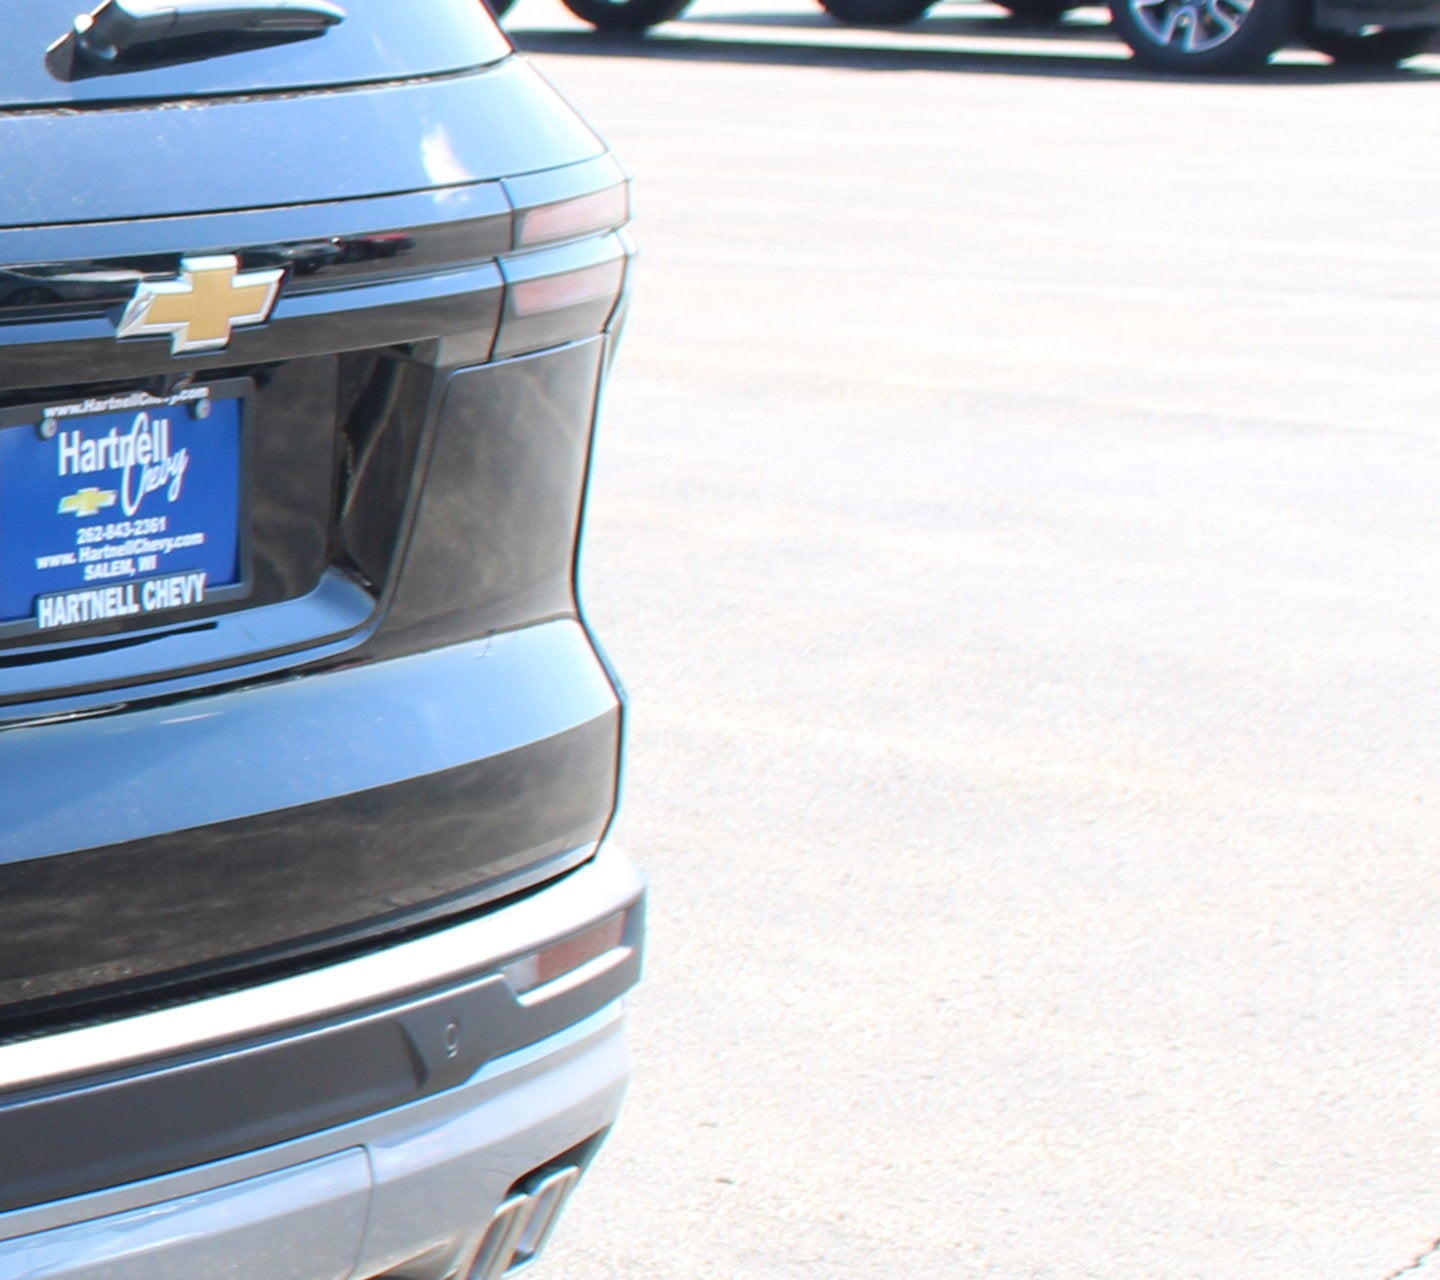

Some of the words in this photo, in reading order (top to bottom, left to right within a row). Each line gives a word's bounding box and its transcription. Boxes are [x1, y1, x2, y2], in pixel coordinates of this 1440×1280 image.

[58, 418, 169, 476] Hartnell
[36, 552, 77, 570] www.
[78, 532, 206, 563] HartnellChevy.com
[84, 558, 137, 581] SALEM,
[138, 554, 158, 572] WI
[38, 584, 141, 629] HARTNELL
[141, 572, 207, 611] CHEVY
